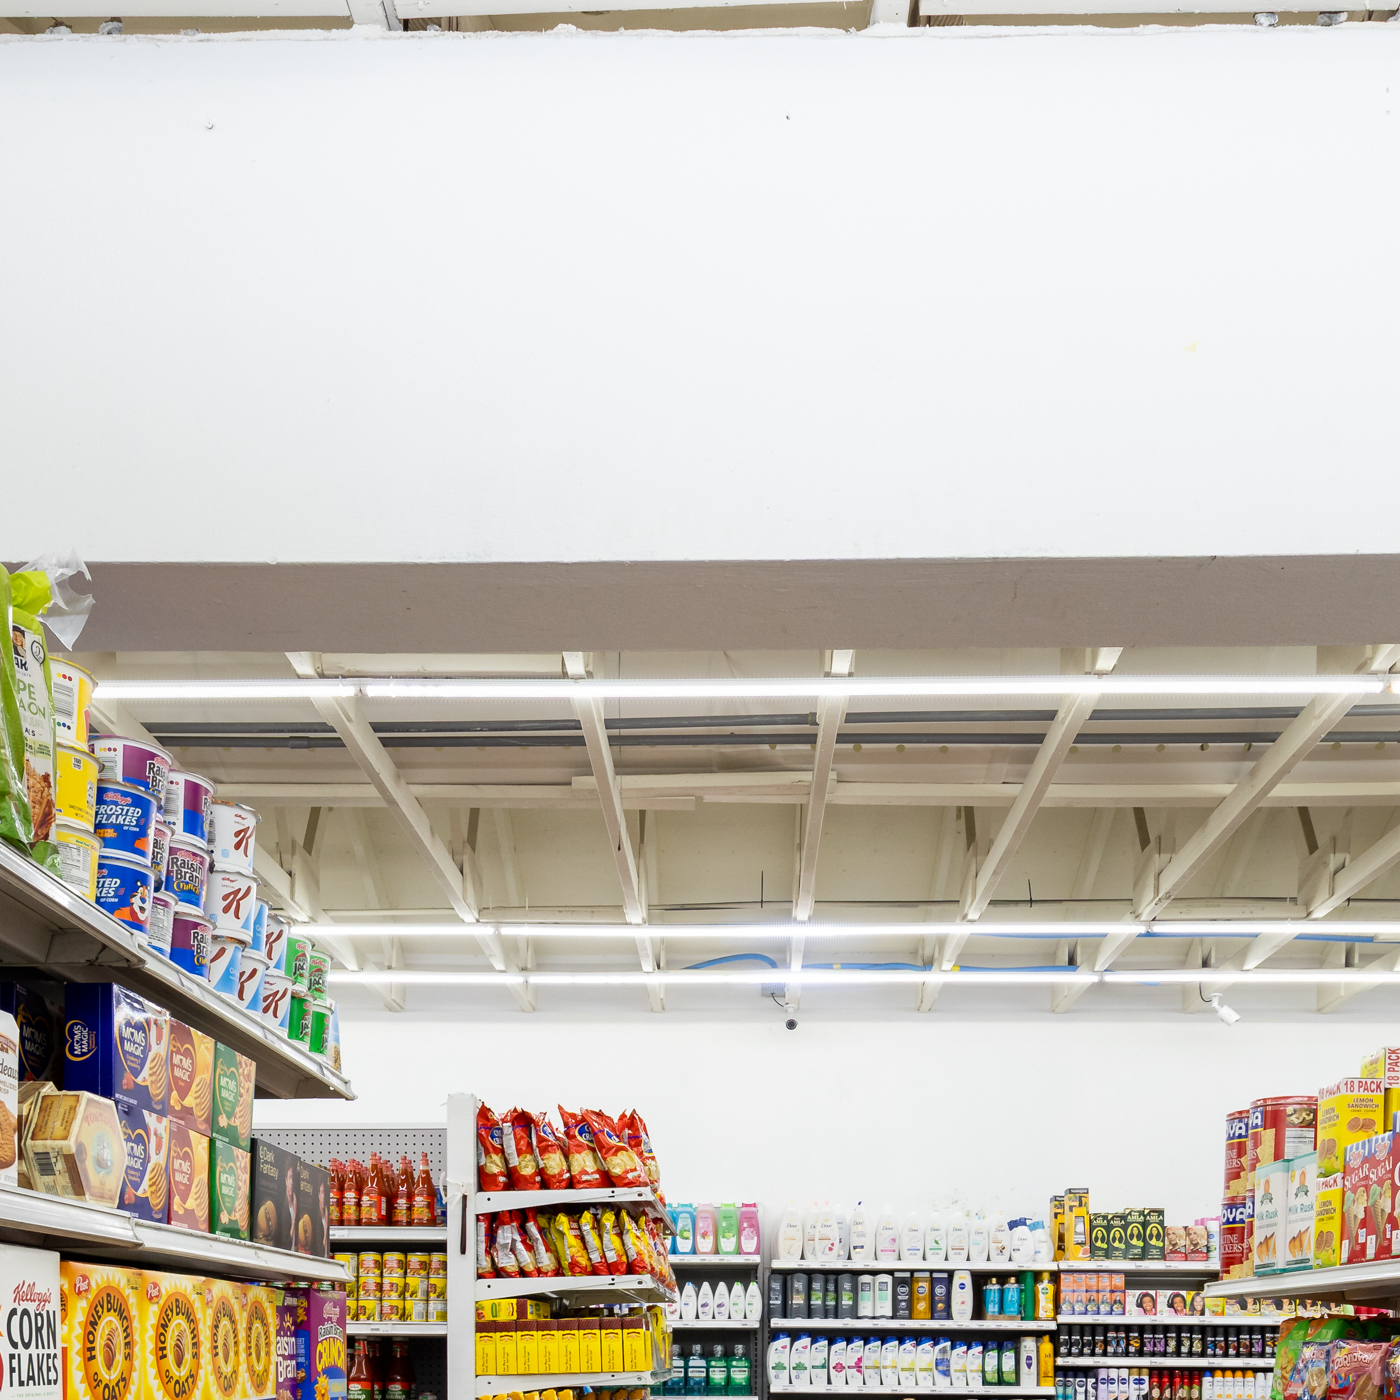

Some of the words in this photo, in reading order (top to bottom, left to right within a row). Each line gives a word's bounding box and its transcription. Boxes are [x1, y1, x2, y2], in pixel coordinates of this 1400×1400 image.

[96, 805, 142, 818] FROSTED
[96, 813, 137, 825] FLAKES
[169, 856, 204, 875] Raisin
[173, 868, 200, 884] Bran
[123, 1040, 144, 1058] MAGIC
[1344, 1080, 1356, 1093] 18
[1357, 1080, 1383, 1094] PACK
[263, 1148, 275, 1162] Dark
[260, 1159, 279, 1179] Fantasy
[1344, 1163, 1369, 1188] SUGAR
[1288, 1203, 1299, 1213] Milk
[1299, 1200, 1315, 1213] Rusk
[75, 1276, 90, 1296] Post
[316, 1337, 344, 1372] CRUNCH
